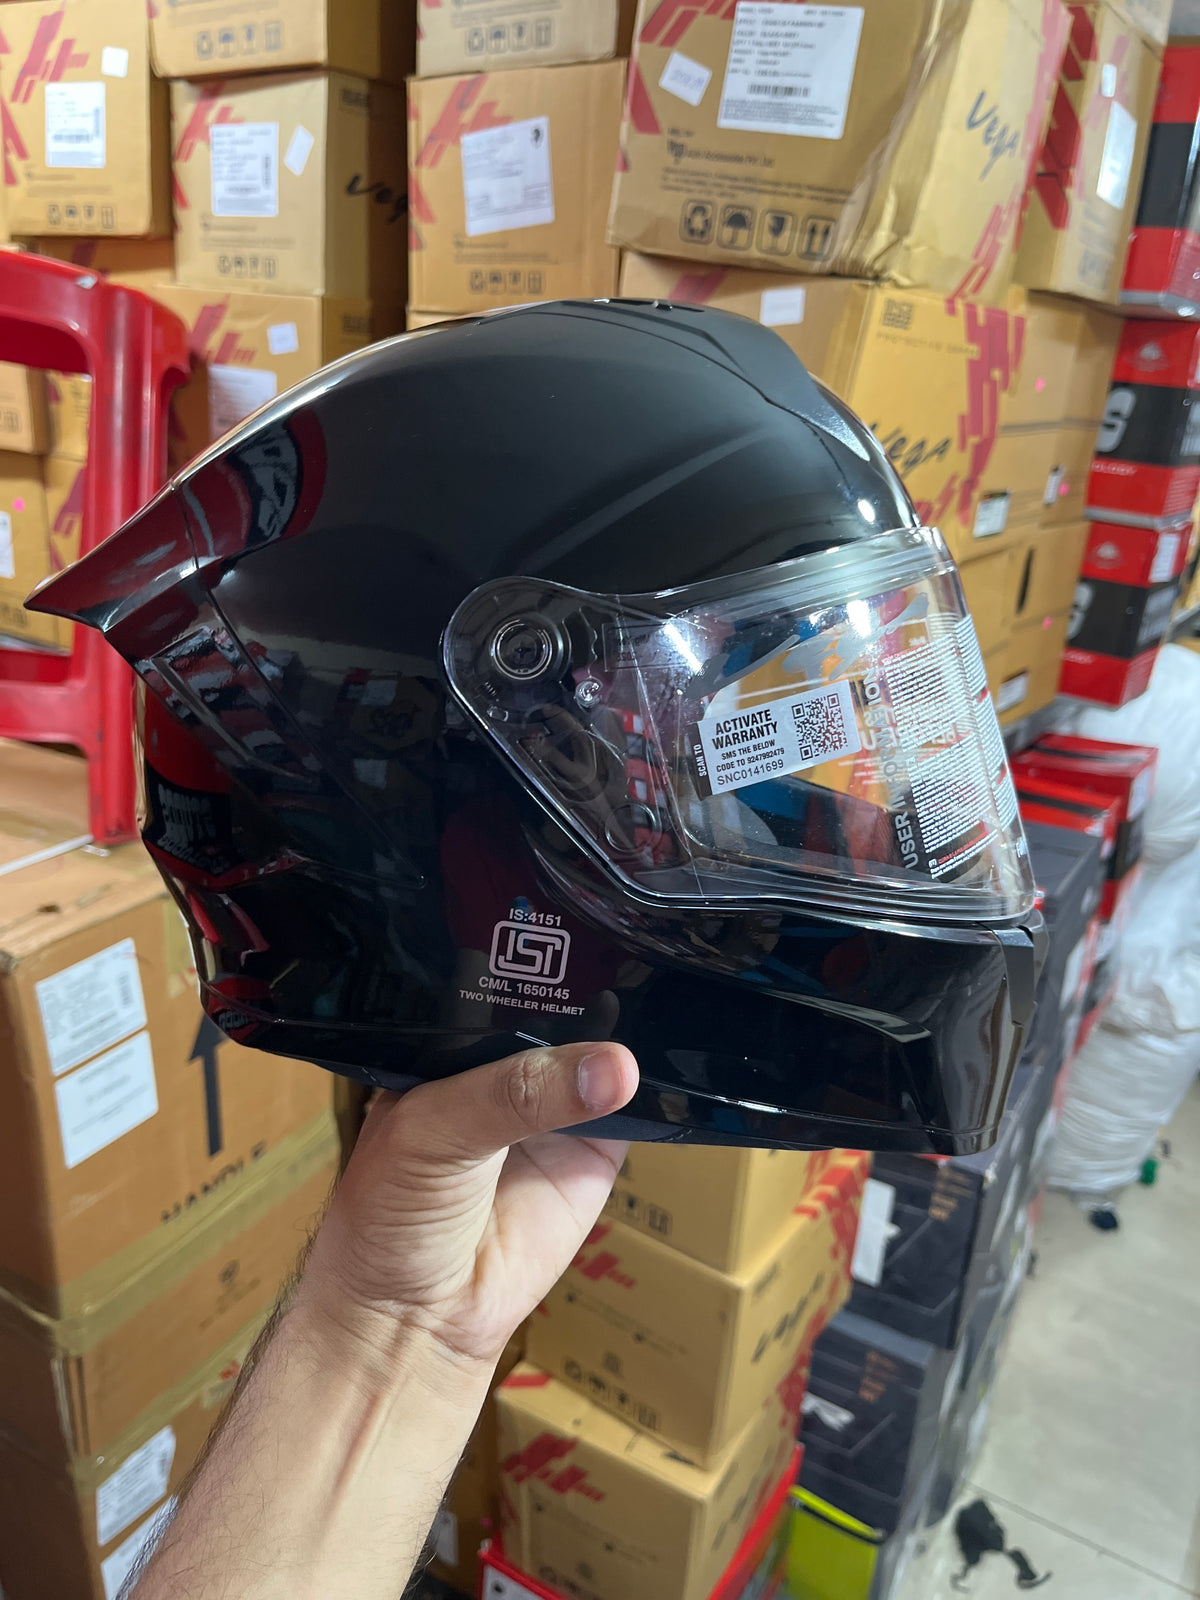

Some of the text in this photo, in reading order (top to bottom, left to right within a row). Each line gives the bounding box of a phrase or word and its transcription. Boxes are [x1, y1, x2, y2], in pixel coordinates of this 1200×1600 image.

[715, 709, 772, 735] ACTIVATE
[712, 721, 778, 750] WARRANTY
[693, 744, 708, 777] SCAN TO
[721, 739, 776, 760] SMS THE BELOW
[716, 762, 735, 773] CODE
[736, 758, 746, 767] TO
[717, 759, 784, 786] SNC0141699
[894, 812, 919, 869] USER
[509, 908, 562, 927] IS:4151
[478, 976, 570, 1000] CM/L 1650145
[459, 989, 585, 1016] TWO WHEELER HELMET
